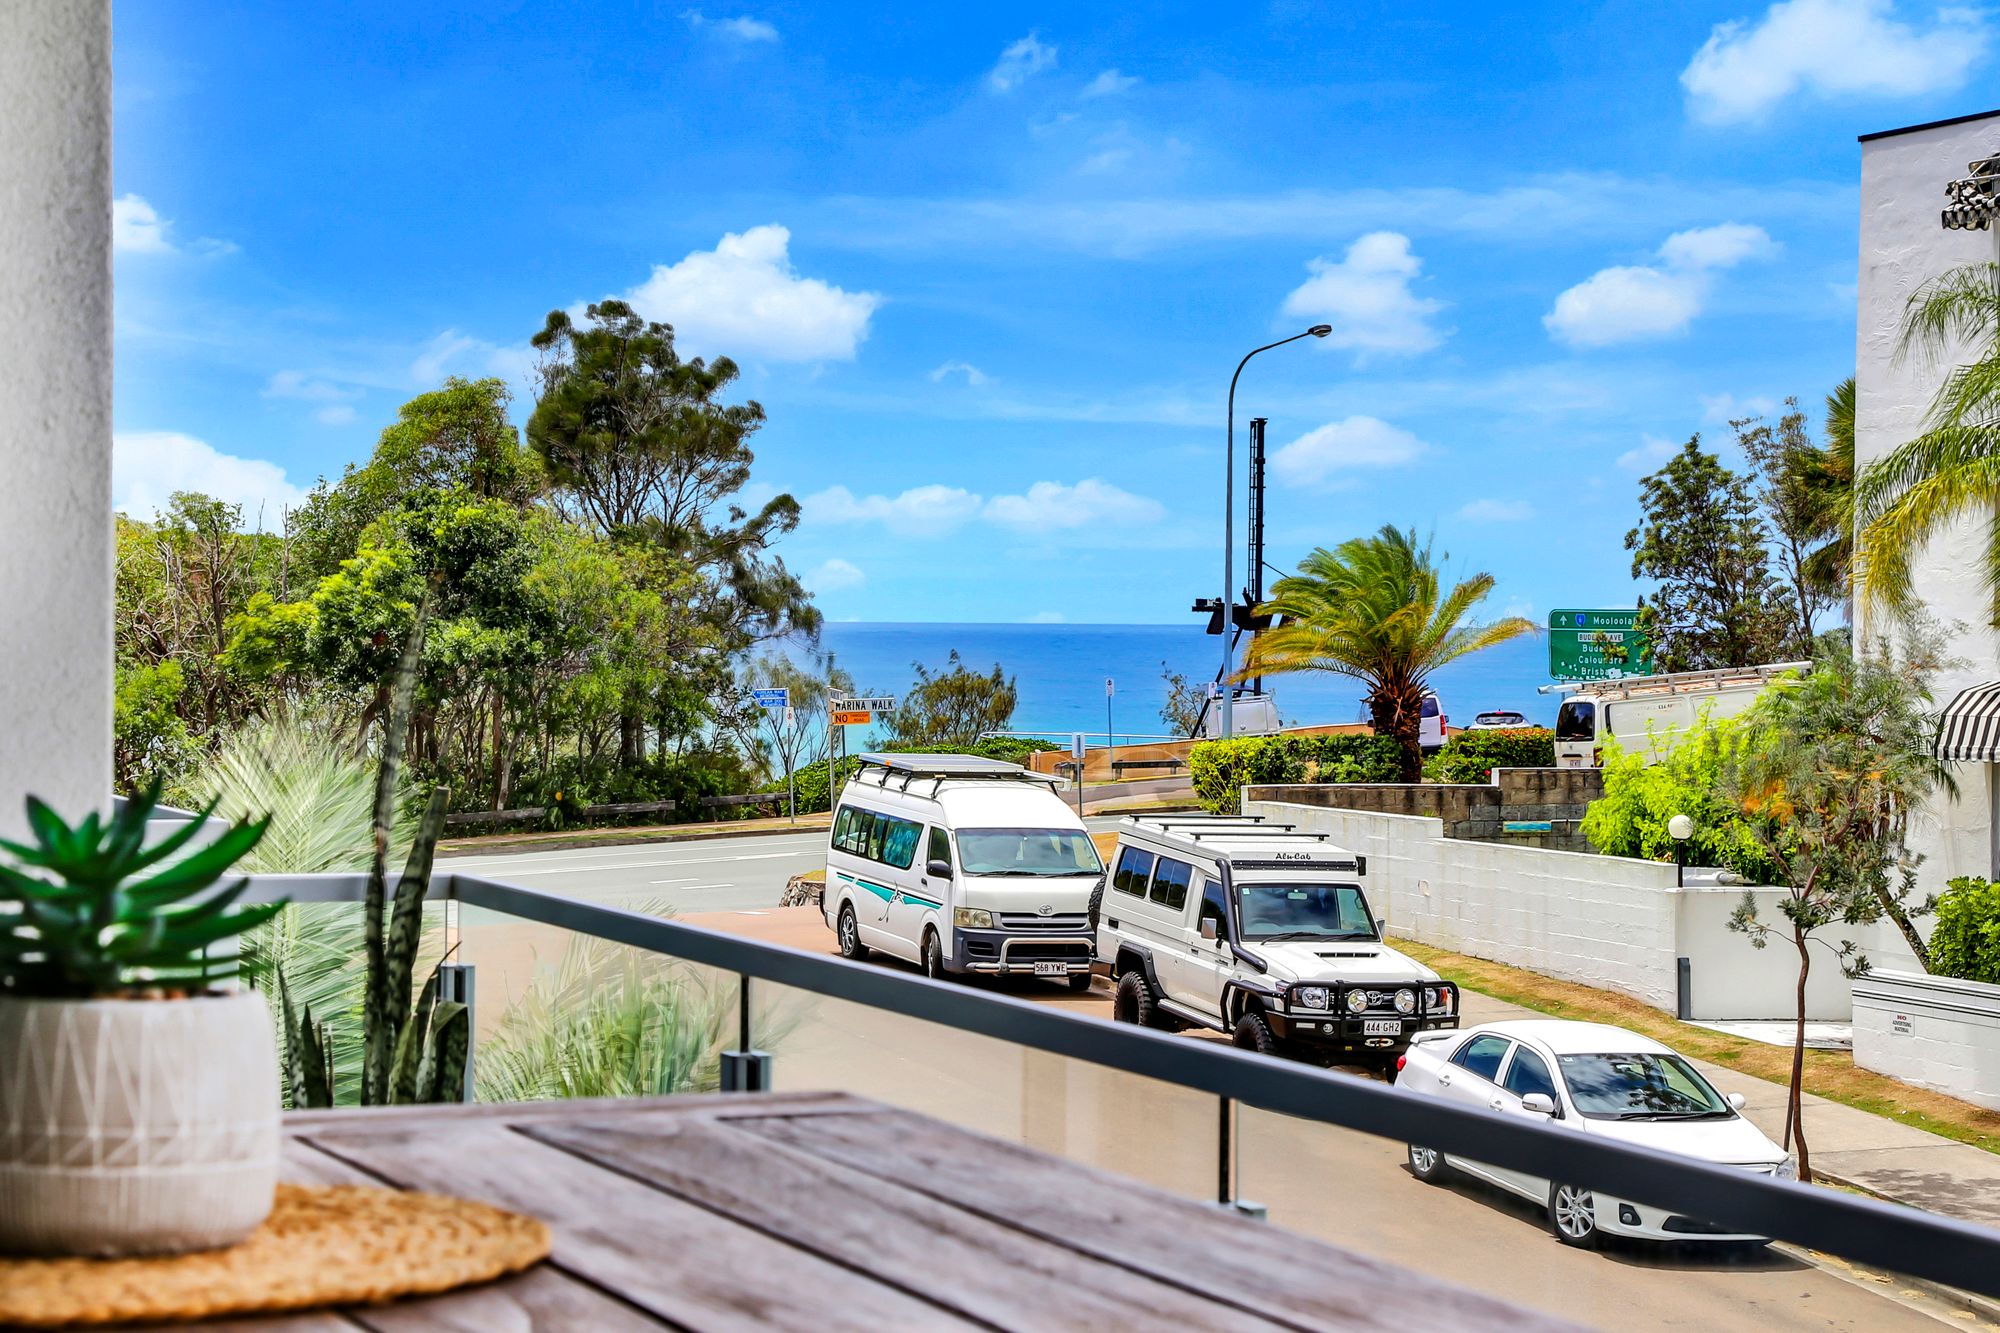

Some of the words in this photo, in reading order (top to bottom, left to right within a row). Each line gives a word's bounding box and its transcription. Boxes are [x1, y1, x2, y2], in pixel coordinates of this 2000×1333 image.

[1593, 616, 1643, 625] Mooloolab
[835, 700, 866, 711] MARINA
[871, 700, 893, 710] WALK
[835, 714, 848, 723] NO
